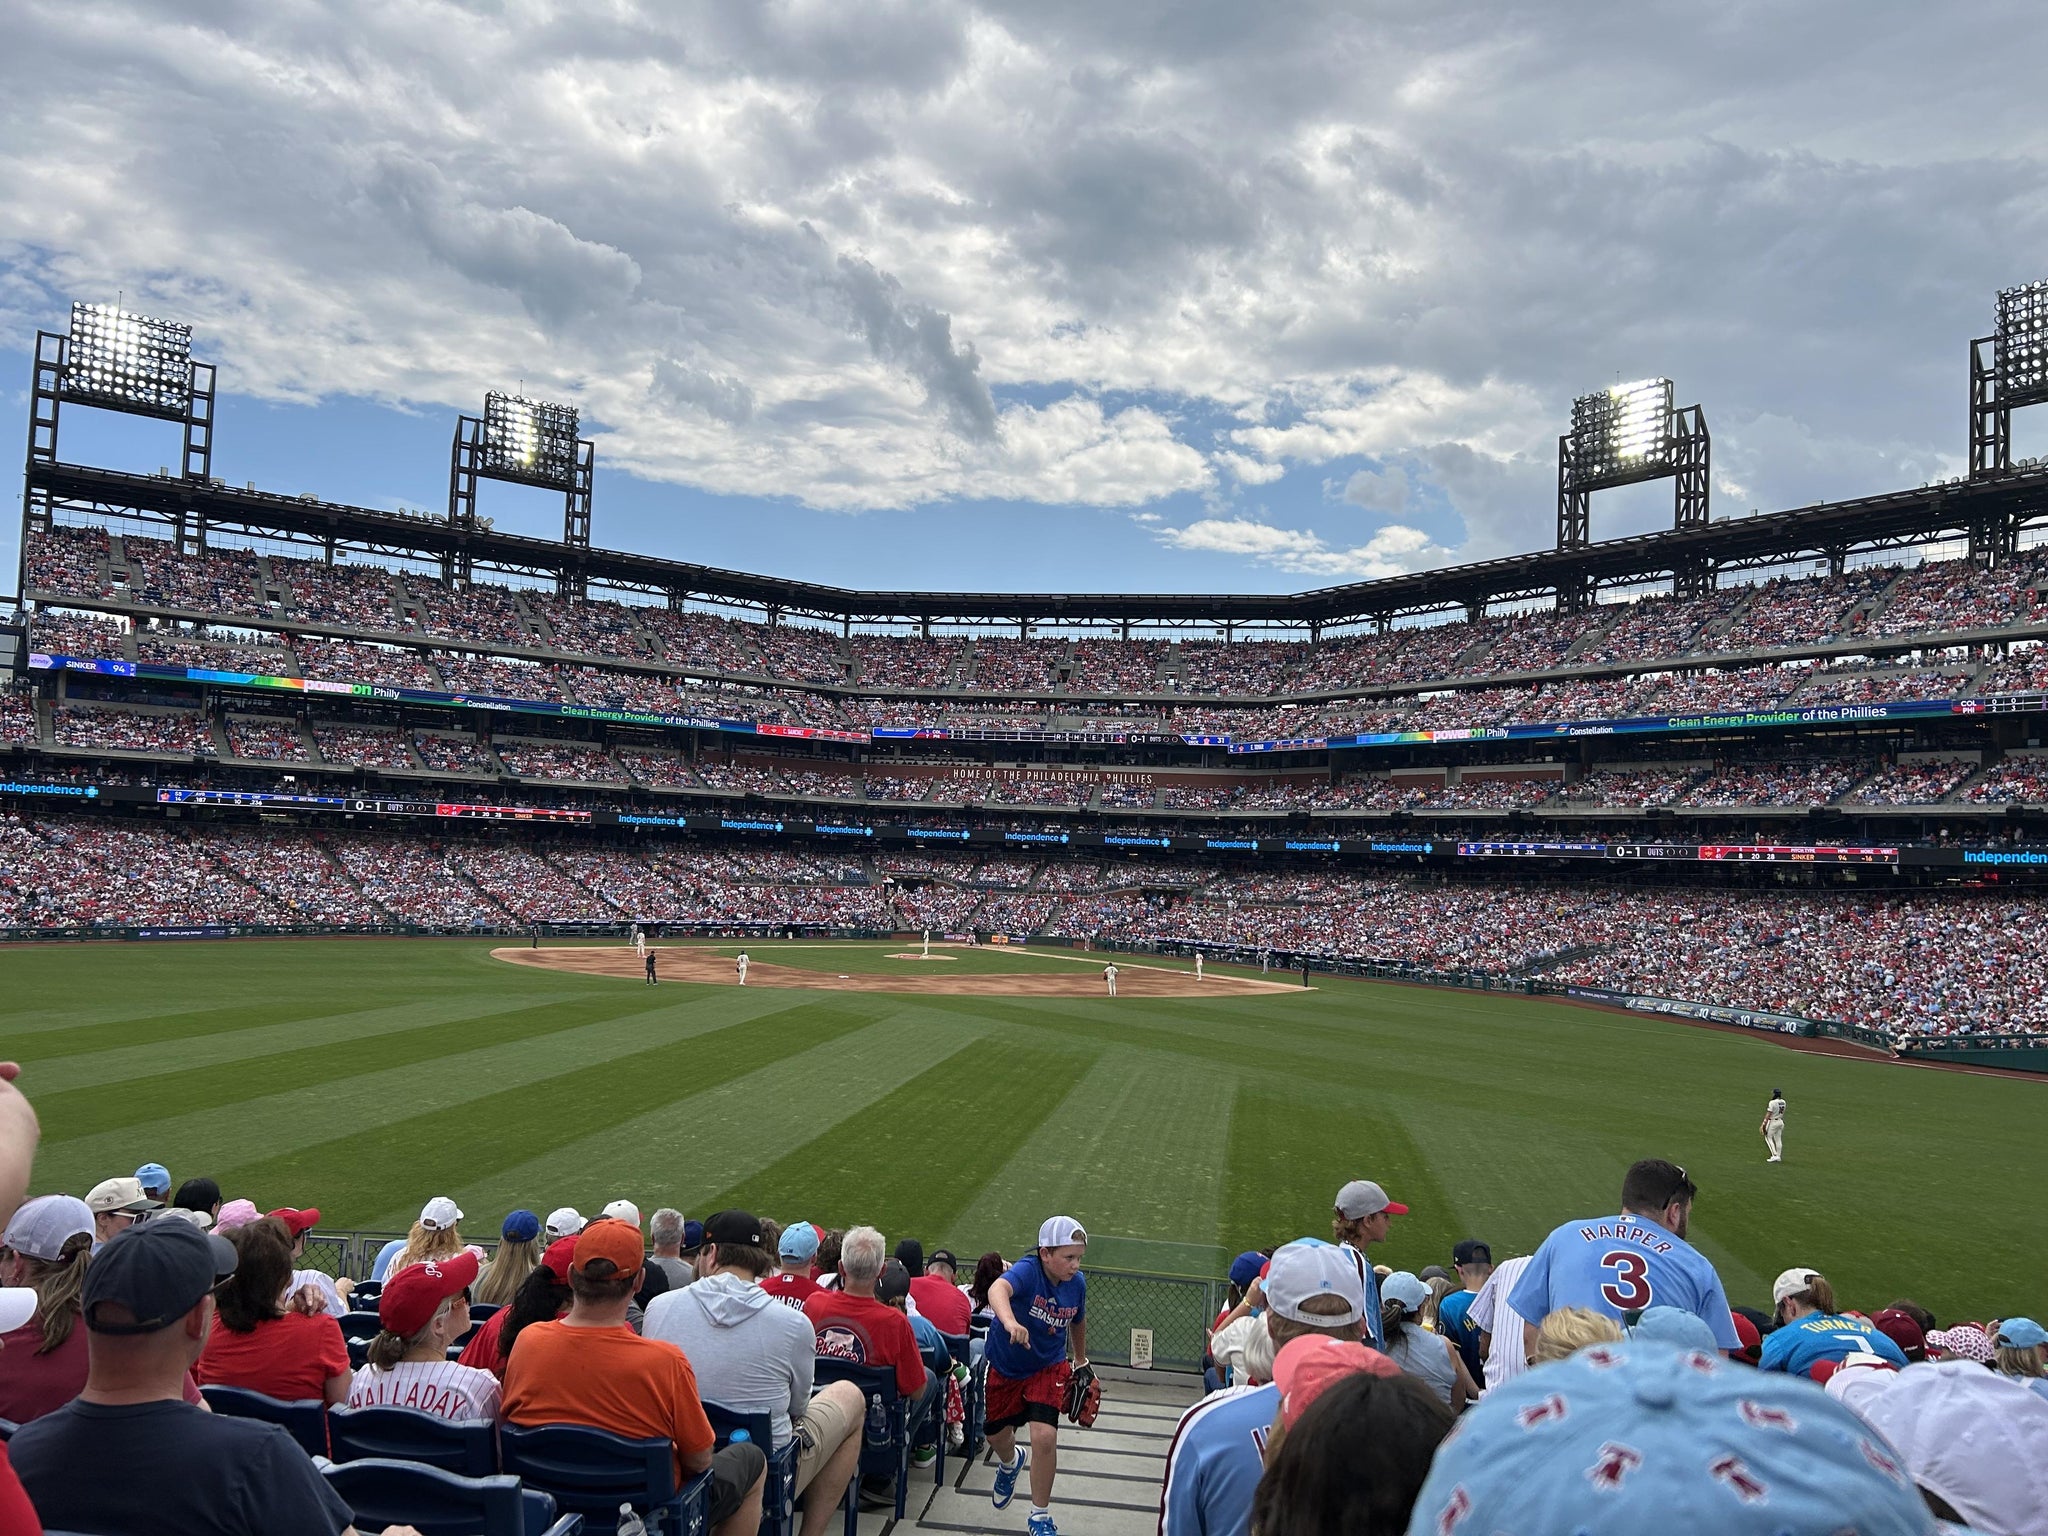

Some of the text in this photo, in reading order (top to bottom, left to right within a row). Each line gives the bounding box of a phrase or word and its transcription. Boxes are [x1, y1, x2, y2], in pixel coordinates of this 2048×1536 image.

[66, 660, 125, 673] SINKER 94
[373, 687, 400, 700] Philly
[467, 700, 511, 711] Constellation
[561, 705, 720, 729] Clean Energy Provider of the Phillies
[1668, 706, 1887, 728] Clean Energy Provider of the Phillies
[1487, 728, 1509, 738] Philly
[1569, 726, 1613, 736] Constellation
[953, 769, 1152, 784] HOME OF THE PHILADELPHIA PHILLIES
[387, 803, 404, 812] OUTS
[618, 814, 676, 825] Independence
[721, 820, 774, 831] Independence
[815, 825, 864, 835] Independence
[907, 829, 961, 839] Independence
[1005, 832, 1059, 843] Independence
[1104, 836, 1160, 846] Independence
[1207, 840, 1250, 849] Independence
[1285, 841, 1332, 851] Independence
[1371, 842, 1423, 853] Independence
[1647, 847, 1663, 856] OUTS
[1964, 850, 2048, 865] Independen
[1660, 1002, 1670, 1013] 10
[1699, 1008, 1709, 1019] 10
[1740, 1015, 1751, 1027] 10
[1785, 1021, 1797, 1033] 10
[1580, 1224, 1673, 1254] HARPER
[1600, 1250, 1653, 1311] 3
[1800, 1319, 1873, 1335] TURNER
[1833, 1335, 1875, 1355] 7
[351, 1381, 466, 1420] HALLADAY
